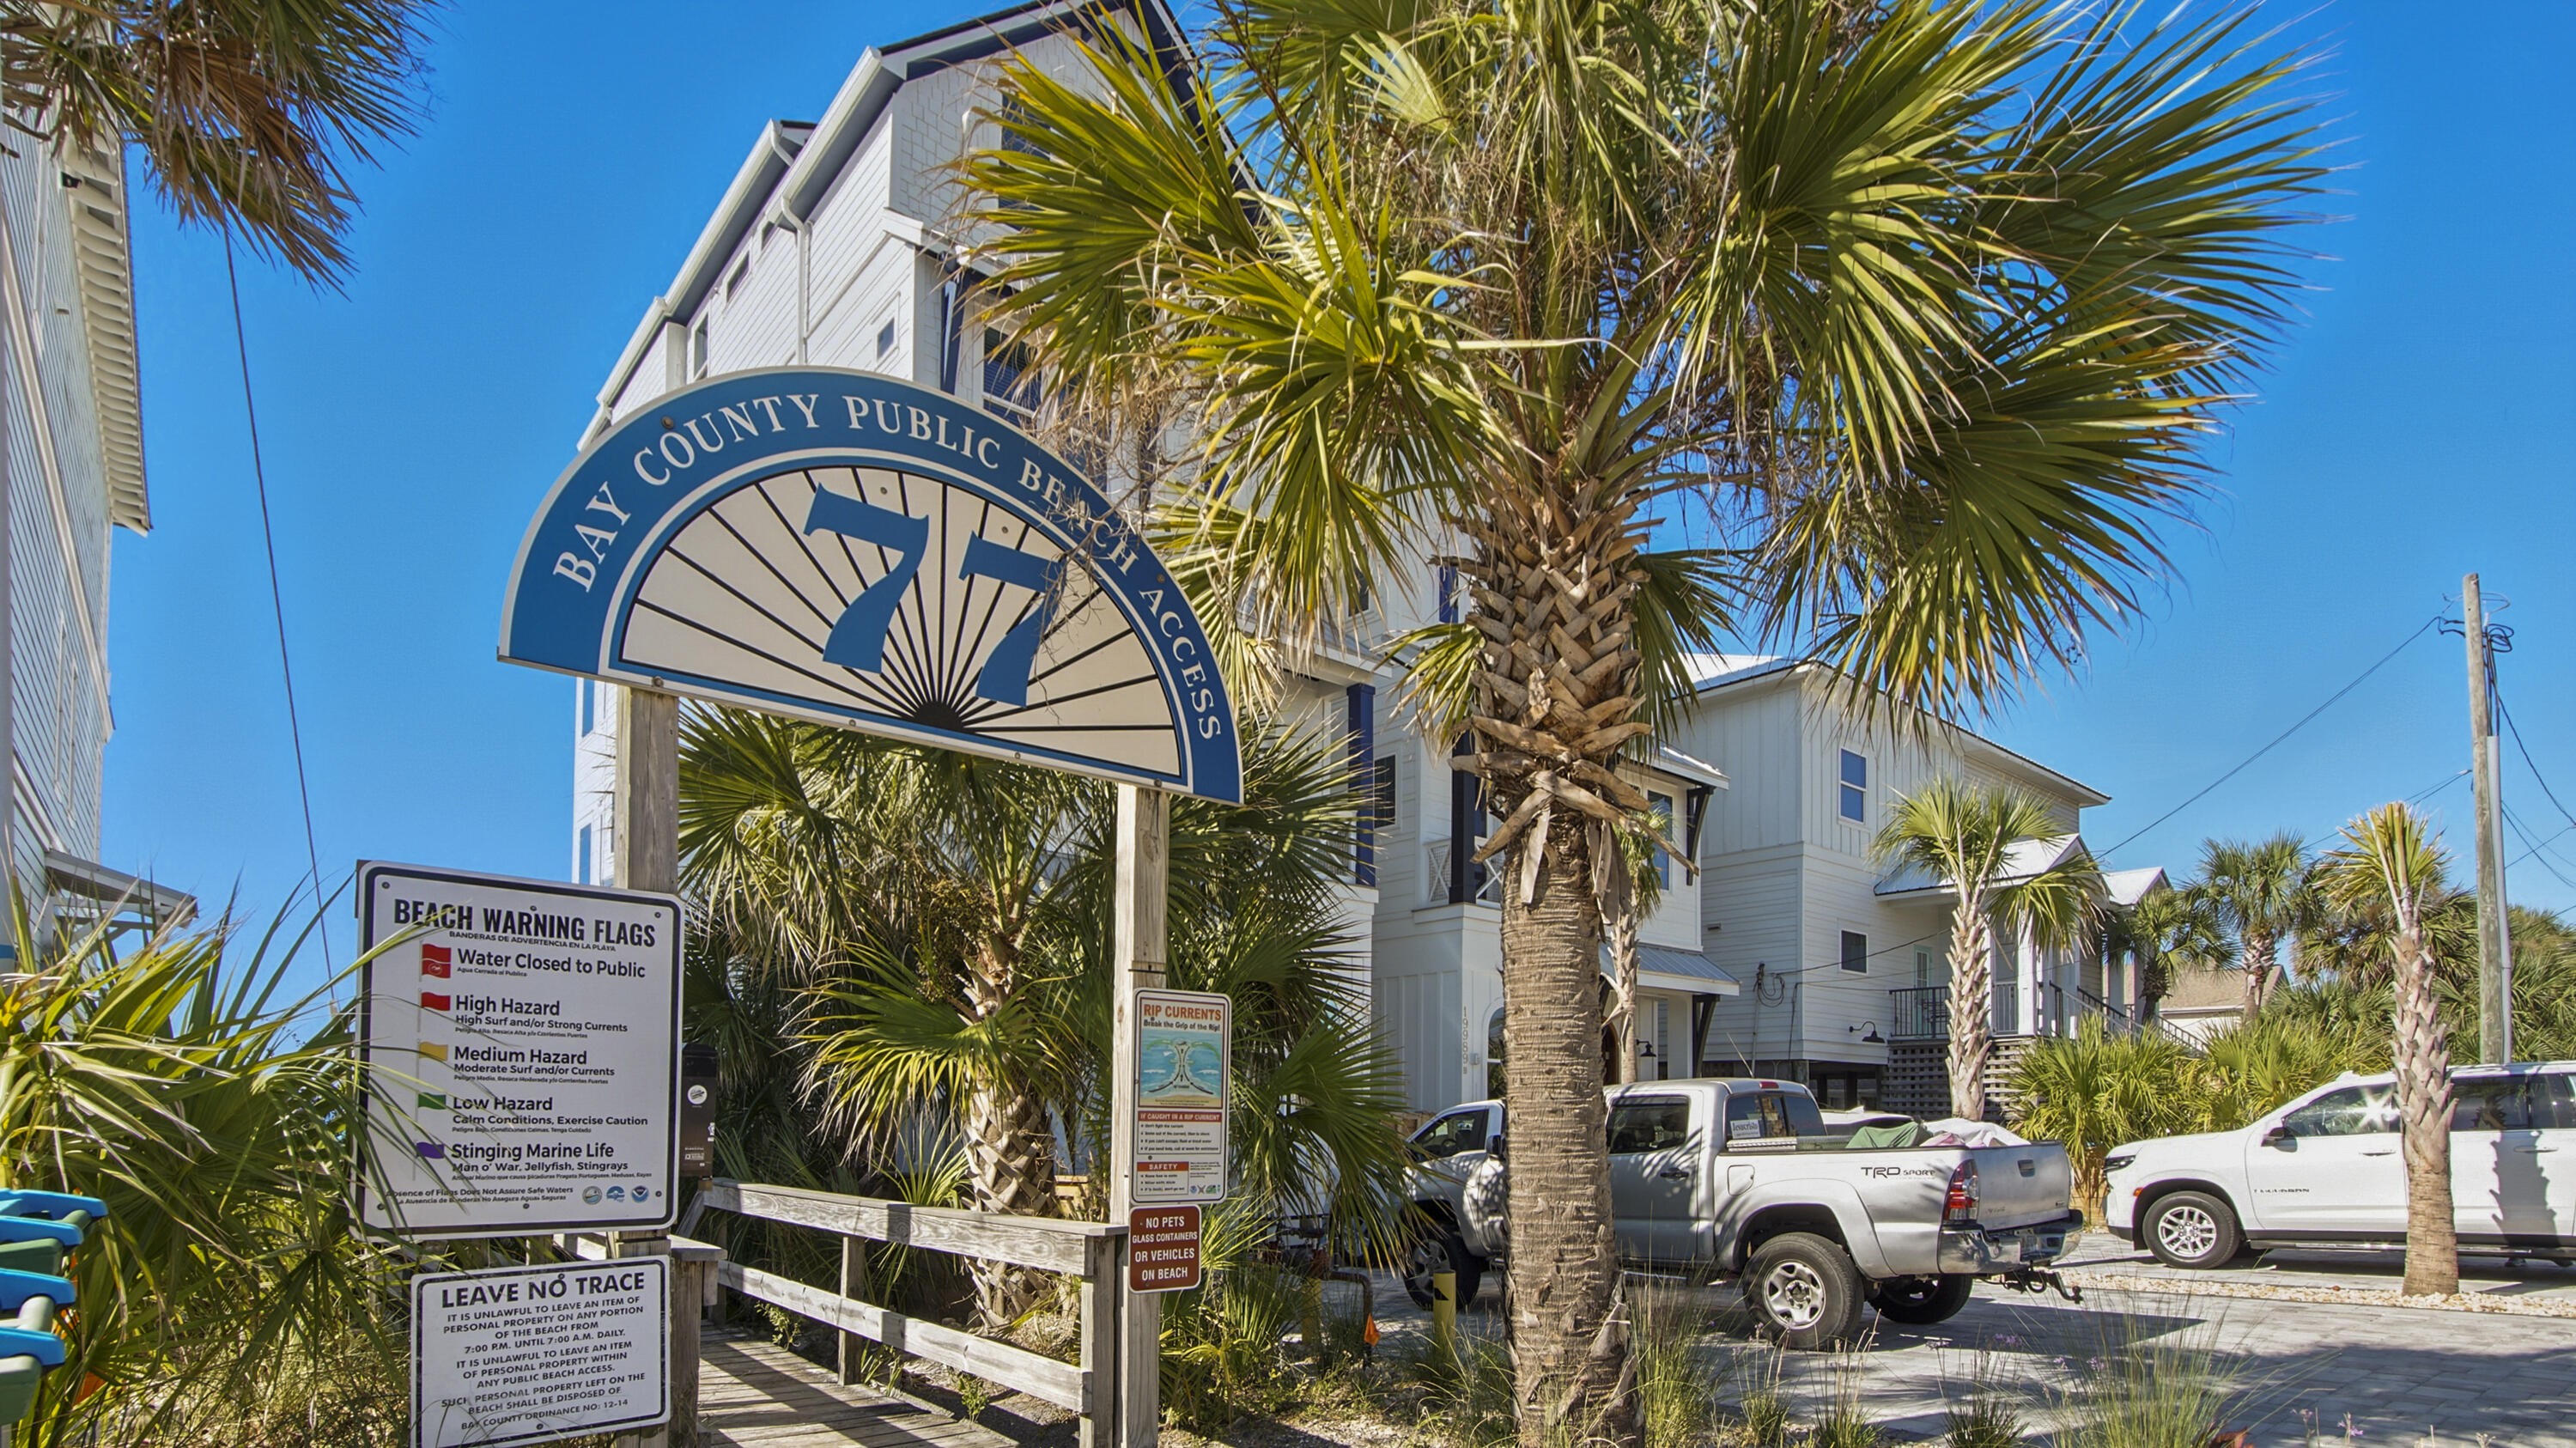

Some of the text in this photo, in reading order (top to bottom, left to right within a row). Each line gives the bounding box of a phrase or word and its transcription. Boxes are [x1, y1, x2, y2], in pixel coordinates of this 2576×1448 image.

[553, 481, 630, 592] BAY
[634, 394, 819, 486] COUNTY
[842, 395, 1000, 469] PUBLIC
[1139, 588, 1221, 739] ACCESS
[803, 482, 1067, 709] 77
[394, 898, 655, 947] BEACH WARNING FLAGS
[449, 931, 496, 941] BANDERAS
[511, 936, 568, 947] ADVERTENCIA
[458, 948, 646, 978] Water Closed to Public
[456, 995, 560, 1016] High Hazard
[1144, 1004, 1222, 1021] RIP CURRENTS
[456, 1014, 628, 1031] High Surf and/or Strong Currents
[1175, 1021, 1188, 1030] Grip
[454, 1046, 586, 1065] Medium Hazard
[453, 1063, 615, 1076] Moderate Surf and/or Currents
[453, 1097, 553, 1110] Low Hazard
[453, 1115, 648, 1125] Calm Conditions, Exercise Caution
[451, 1142, 614, 1161] Stinging Marine Life
[453, 1163, 479, 1171] Man
[577, 1161, 629, 1171] Stingrays
[1861, 1166, 1901, 1178] TRD
[1145, 1215, 1185, 1229] NO PETS
[1132, 1231, 1198, 1244] GLASS CONTAINERS
[1135, 1247, 1195, 1262] OR VEHICLES
[1141, 1266, 1188, 1281] ON BEACH
[441, 1272, 644, 1308] LEAVE NO TRACE
[461, 1312, 471, 1321] IS
[474, 1307, 532, 1320] UNLAWFUL
[552, 1302, 581, 1312] LEAVE
[584, 1300, 598, 1309] AN
[602, 1298, 624, 1306] ITEM
[443, 1306, 643, 1334] PERSONAL PROPERTY ON ANY PORTION
[495, 1322, 598, 1340] OF THE BEACH FROM
[465, 1329, 625, 1354] 7:00 P.M. UNTIL 7:00 A.M. DAILY.
[457, 1360, 466, 1369] IT
[470, 1359, 479, 1367] IS
[483, 1352, 540, 1366] UNLAWFUL
[560, 1346, 590, 1356] LEAVE
[592, 1344, 607, 1353] AN
[610, 1341, 632, 1350] ITEM
[463, 1352, 628, 1378] OF PERSONAL PROPERTY WITHIN
[477, 1364, 616, 1389] ANY PUBLIC BEACH ACCESS.
[475, 1389, 530, 1403] PERSONAL
[533, 1381, 583, 1395] PROPERTY
[586, 1378, 606, 1388] LEFT
[609, 1376, 625, 1384] ON
[628, 1372, 646, 1382] THE
[468, 1386, 621, 1415] BEACH SHALL BE DISPOSED OF
[483, 1414, 523, 1427] COUNTY
[525, 1406, 580, 1420] ORDINANCE
[604, 1399, 629, 1408] 12-14
